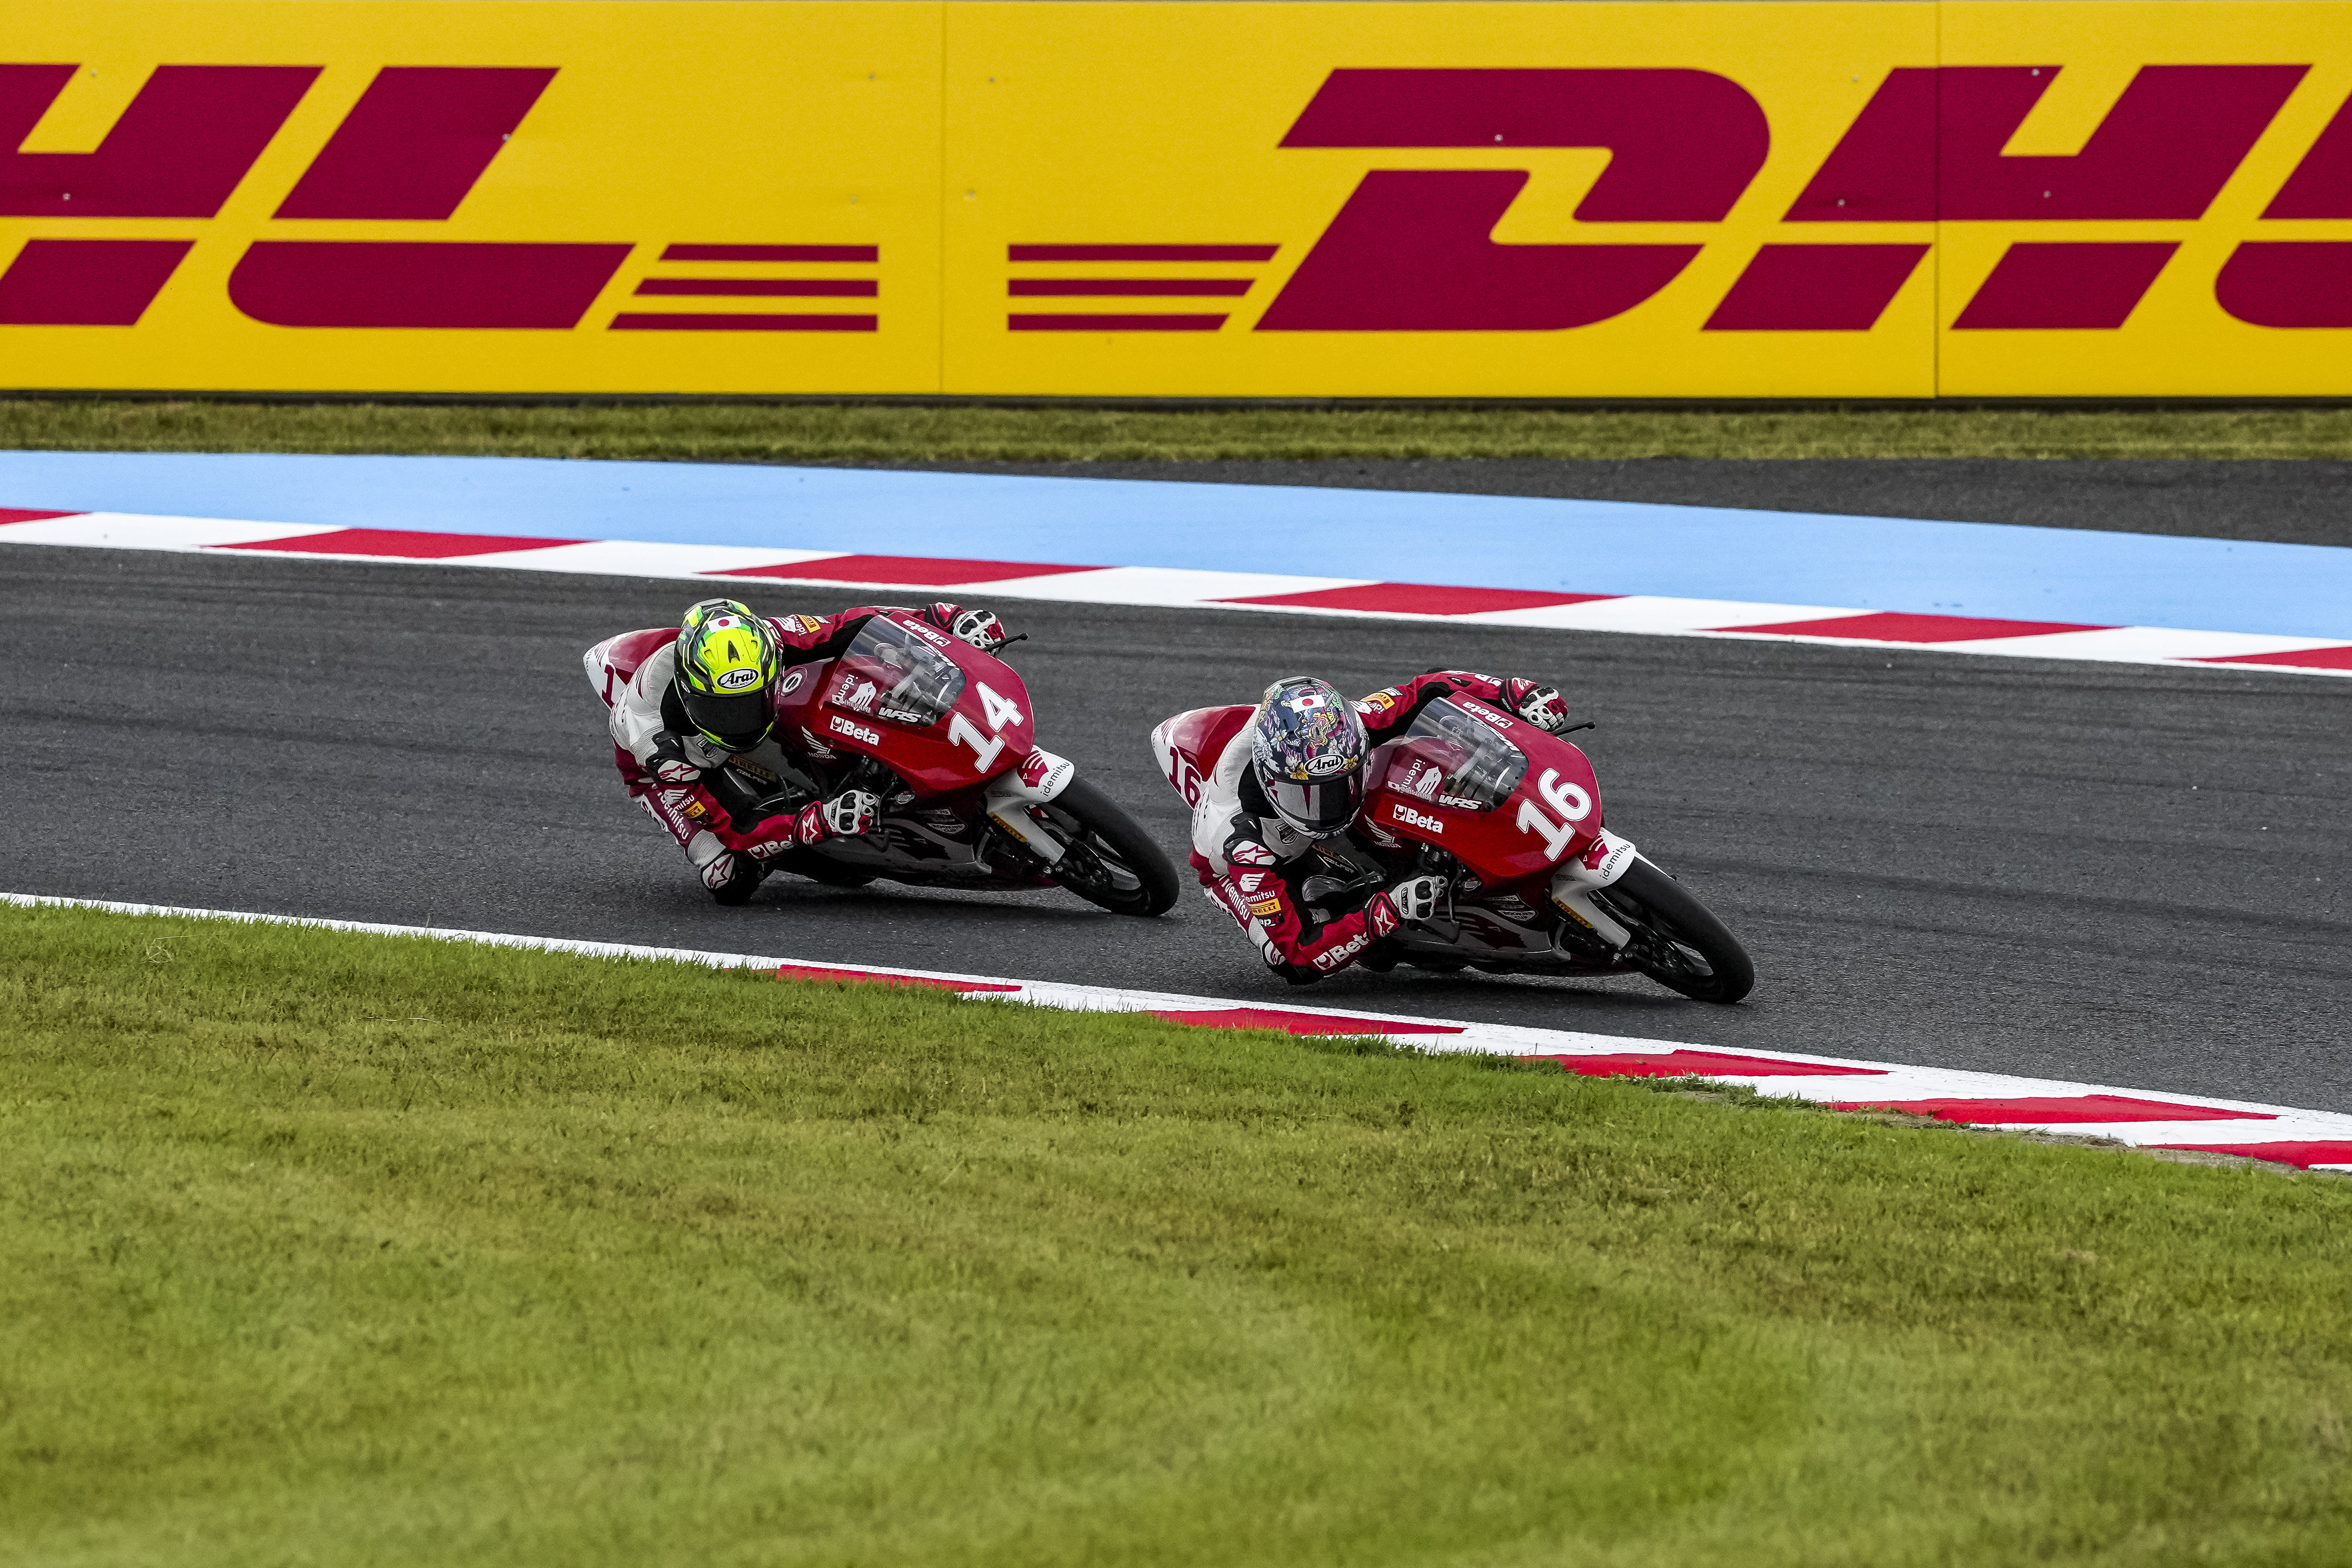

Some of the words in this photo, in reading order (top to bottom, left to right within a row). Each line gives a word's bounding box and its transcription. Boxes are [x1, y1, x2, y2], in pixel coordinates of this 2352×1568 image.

[903, 619, 939, 640] Beta
[721, 669, 755, 686] Arai
[878, 707, 921, 723] WRS
[1462, 701, 1504, 723] Beta
[842, 720, 880, 745] Beta
[948, 681, 1024, 774] 14
[1308, 755, 1340, 771] Arai
[1040, 762, 1070, 797] idemitsu
[1169, 746, 1202, 808] 16
[1439, 794, 1482, 809] WRS
[1407, 808, 1444, 833] Beta
[1516, 767, 1592, 861] 16
[1600, 843, 1631, 881] idemitsu
[1245, 890, 1275, 902] emitsu
